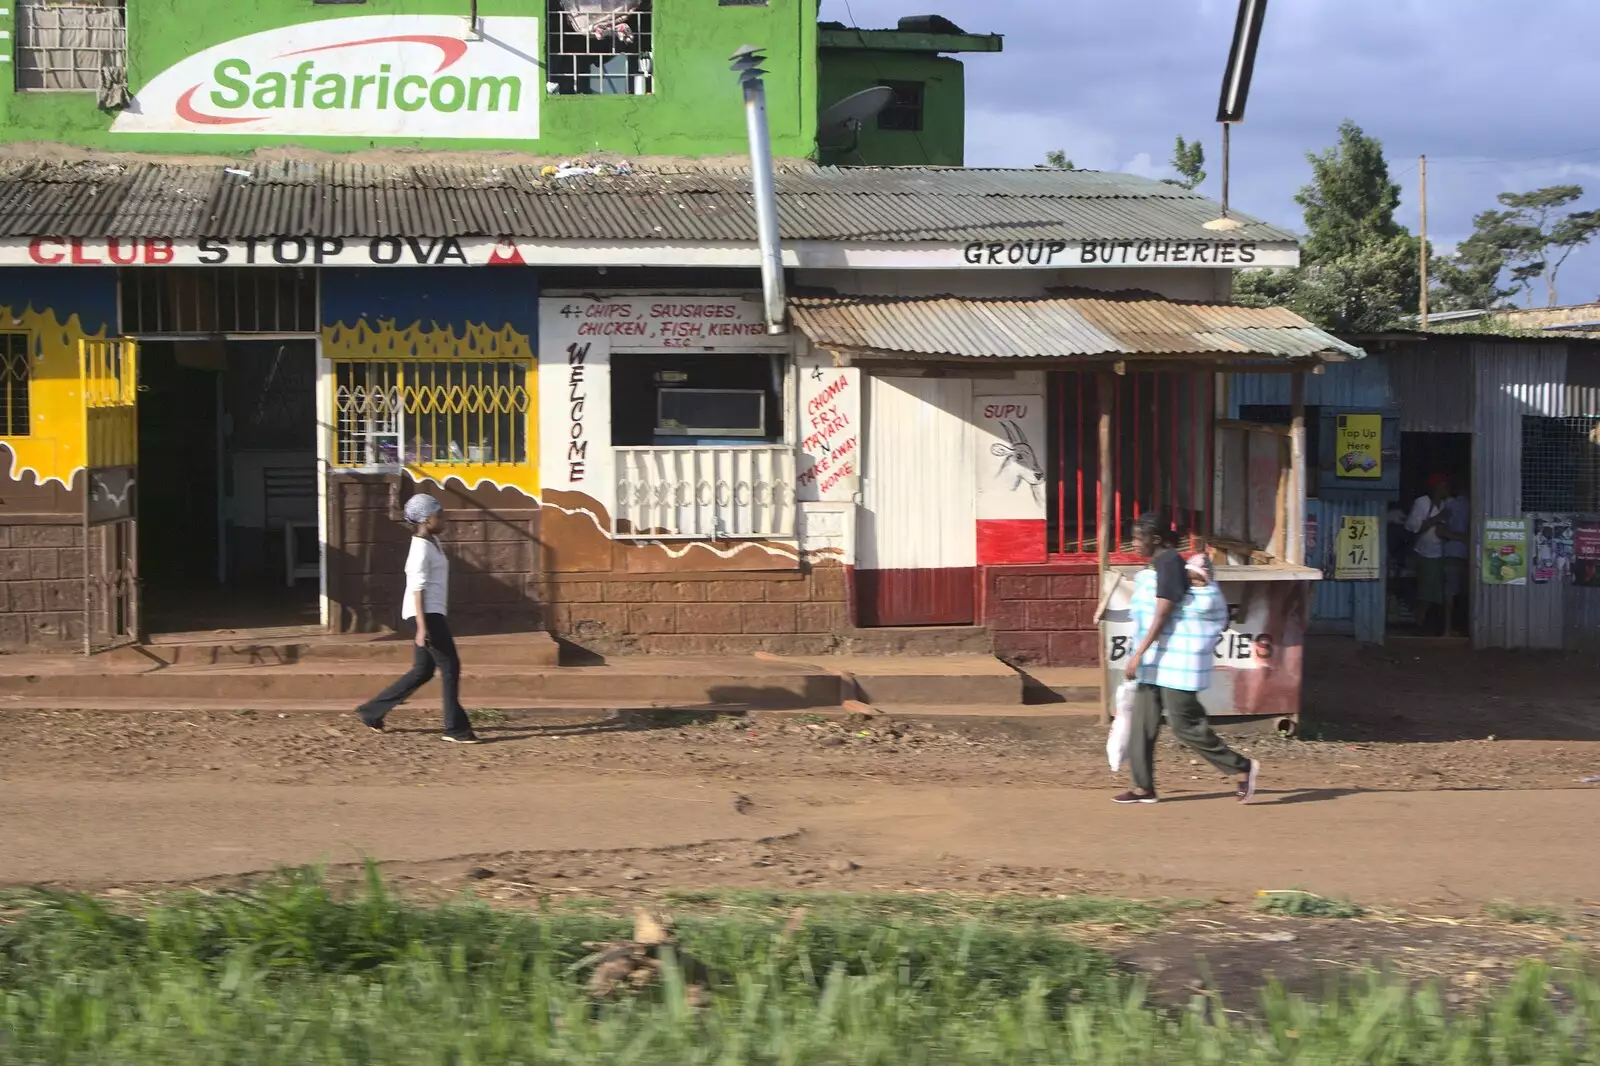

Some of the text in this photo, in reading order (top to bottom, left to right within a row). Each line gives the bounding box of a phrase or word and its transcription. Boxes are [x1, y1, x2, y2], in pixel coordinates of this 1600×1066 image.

[210, 58, 522, 113] Safaricom
[28, 236, 468, 265] CLUB STOP OVA
[963, 240, 1257, 265] GROUP BUTCHERIES
[808, 374, 848, 415] CHOMA
[565, 342, 592, 482] WELCOME
[811, 404, 837, 429] FRY
[984, 404, 1027, 418] SUPU
[801, 413, 849, 452] TAYARI
[1341, 428, 1377, 440] Top Up
[1347, 441, 1371, 450] Here
[797, 434, 857, 486] TAKE AWAY
[820, 461, 853, 493] HOME
[1348, 525, 1368, 540] 3/-
